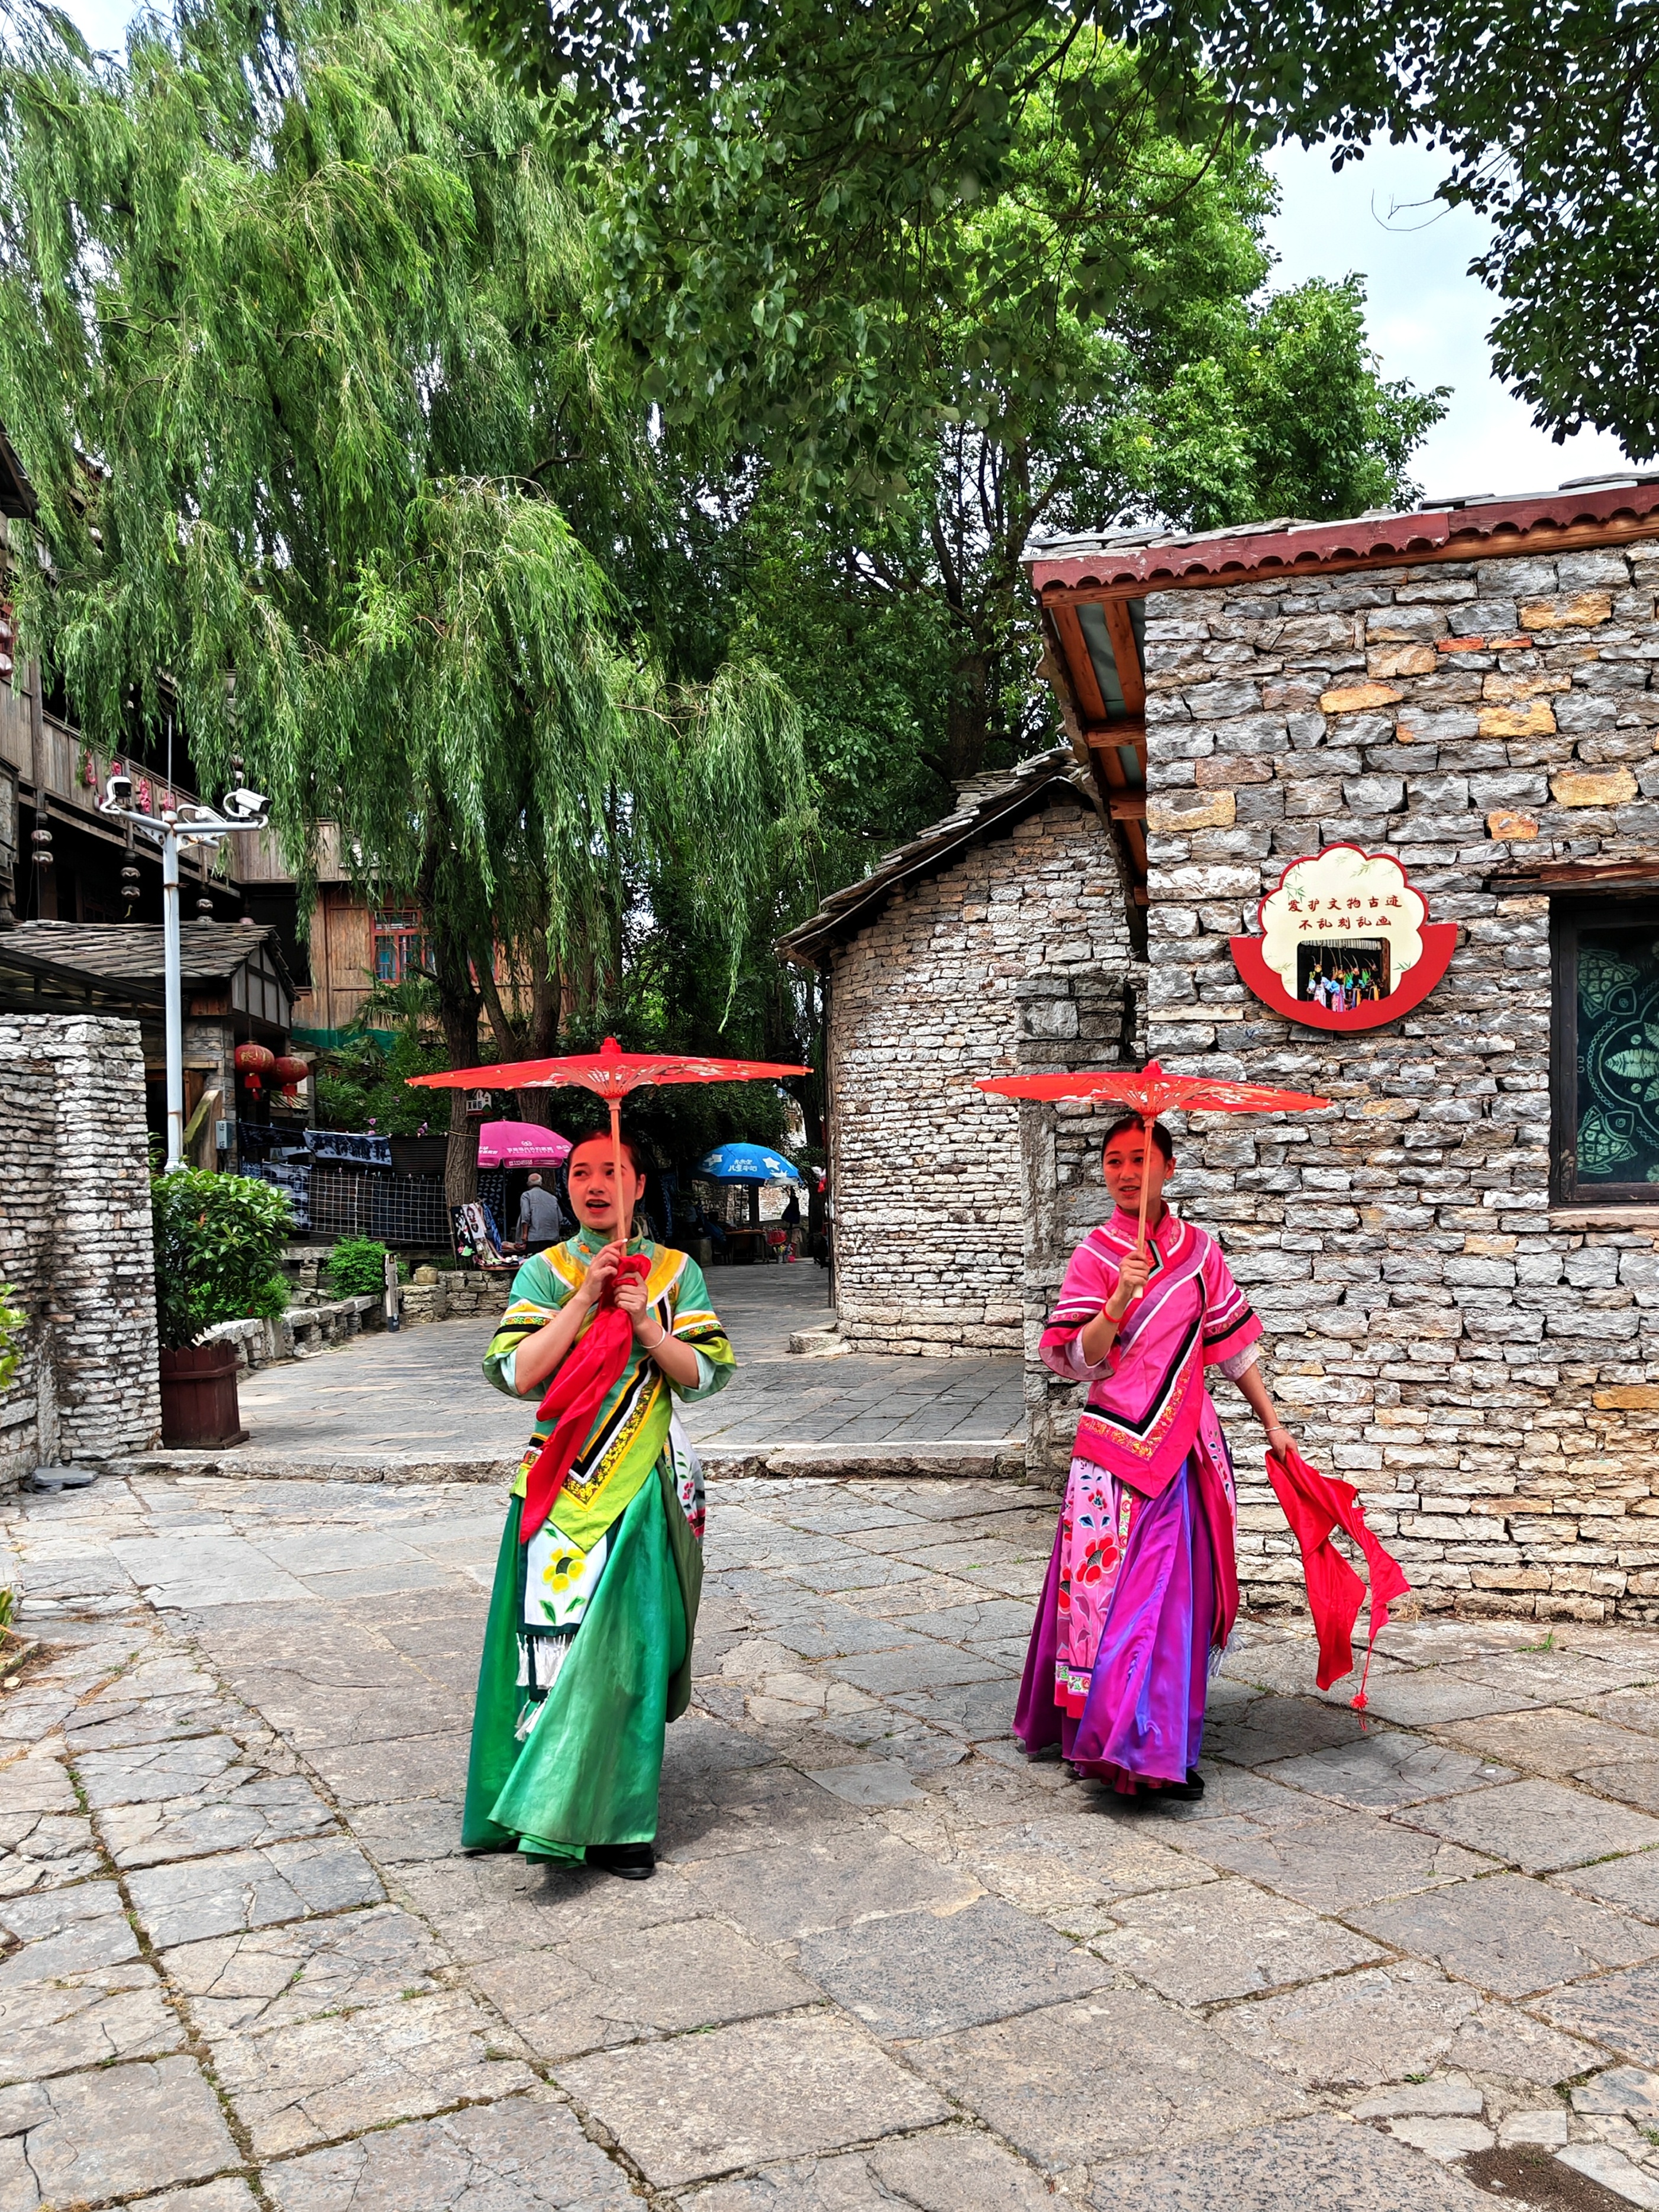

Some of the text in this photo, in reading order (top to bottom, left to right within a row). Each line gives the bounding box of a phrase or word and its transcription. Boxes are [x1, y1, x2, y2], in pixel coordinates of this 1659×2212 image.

[1288, 895, 1402, 912] 爱护文物古迹
[1299, 916, 1392, 931] 不乱刻乱画
